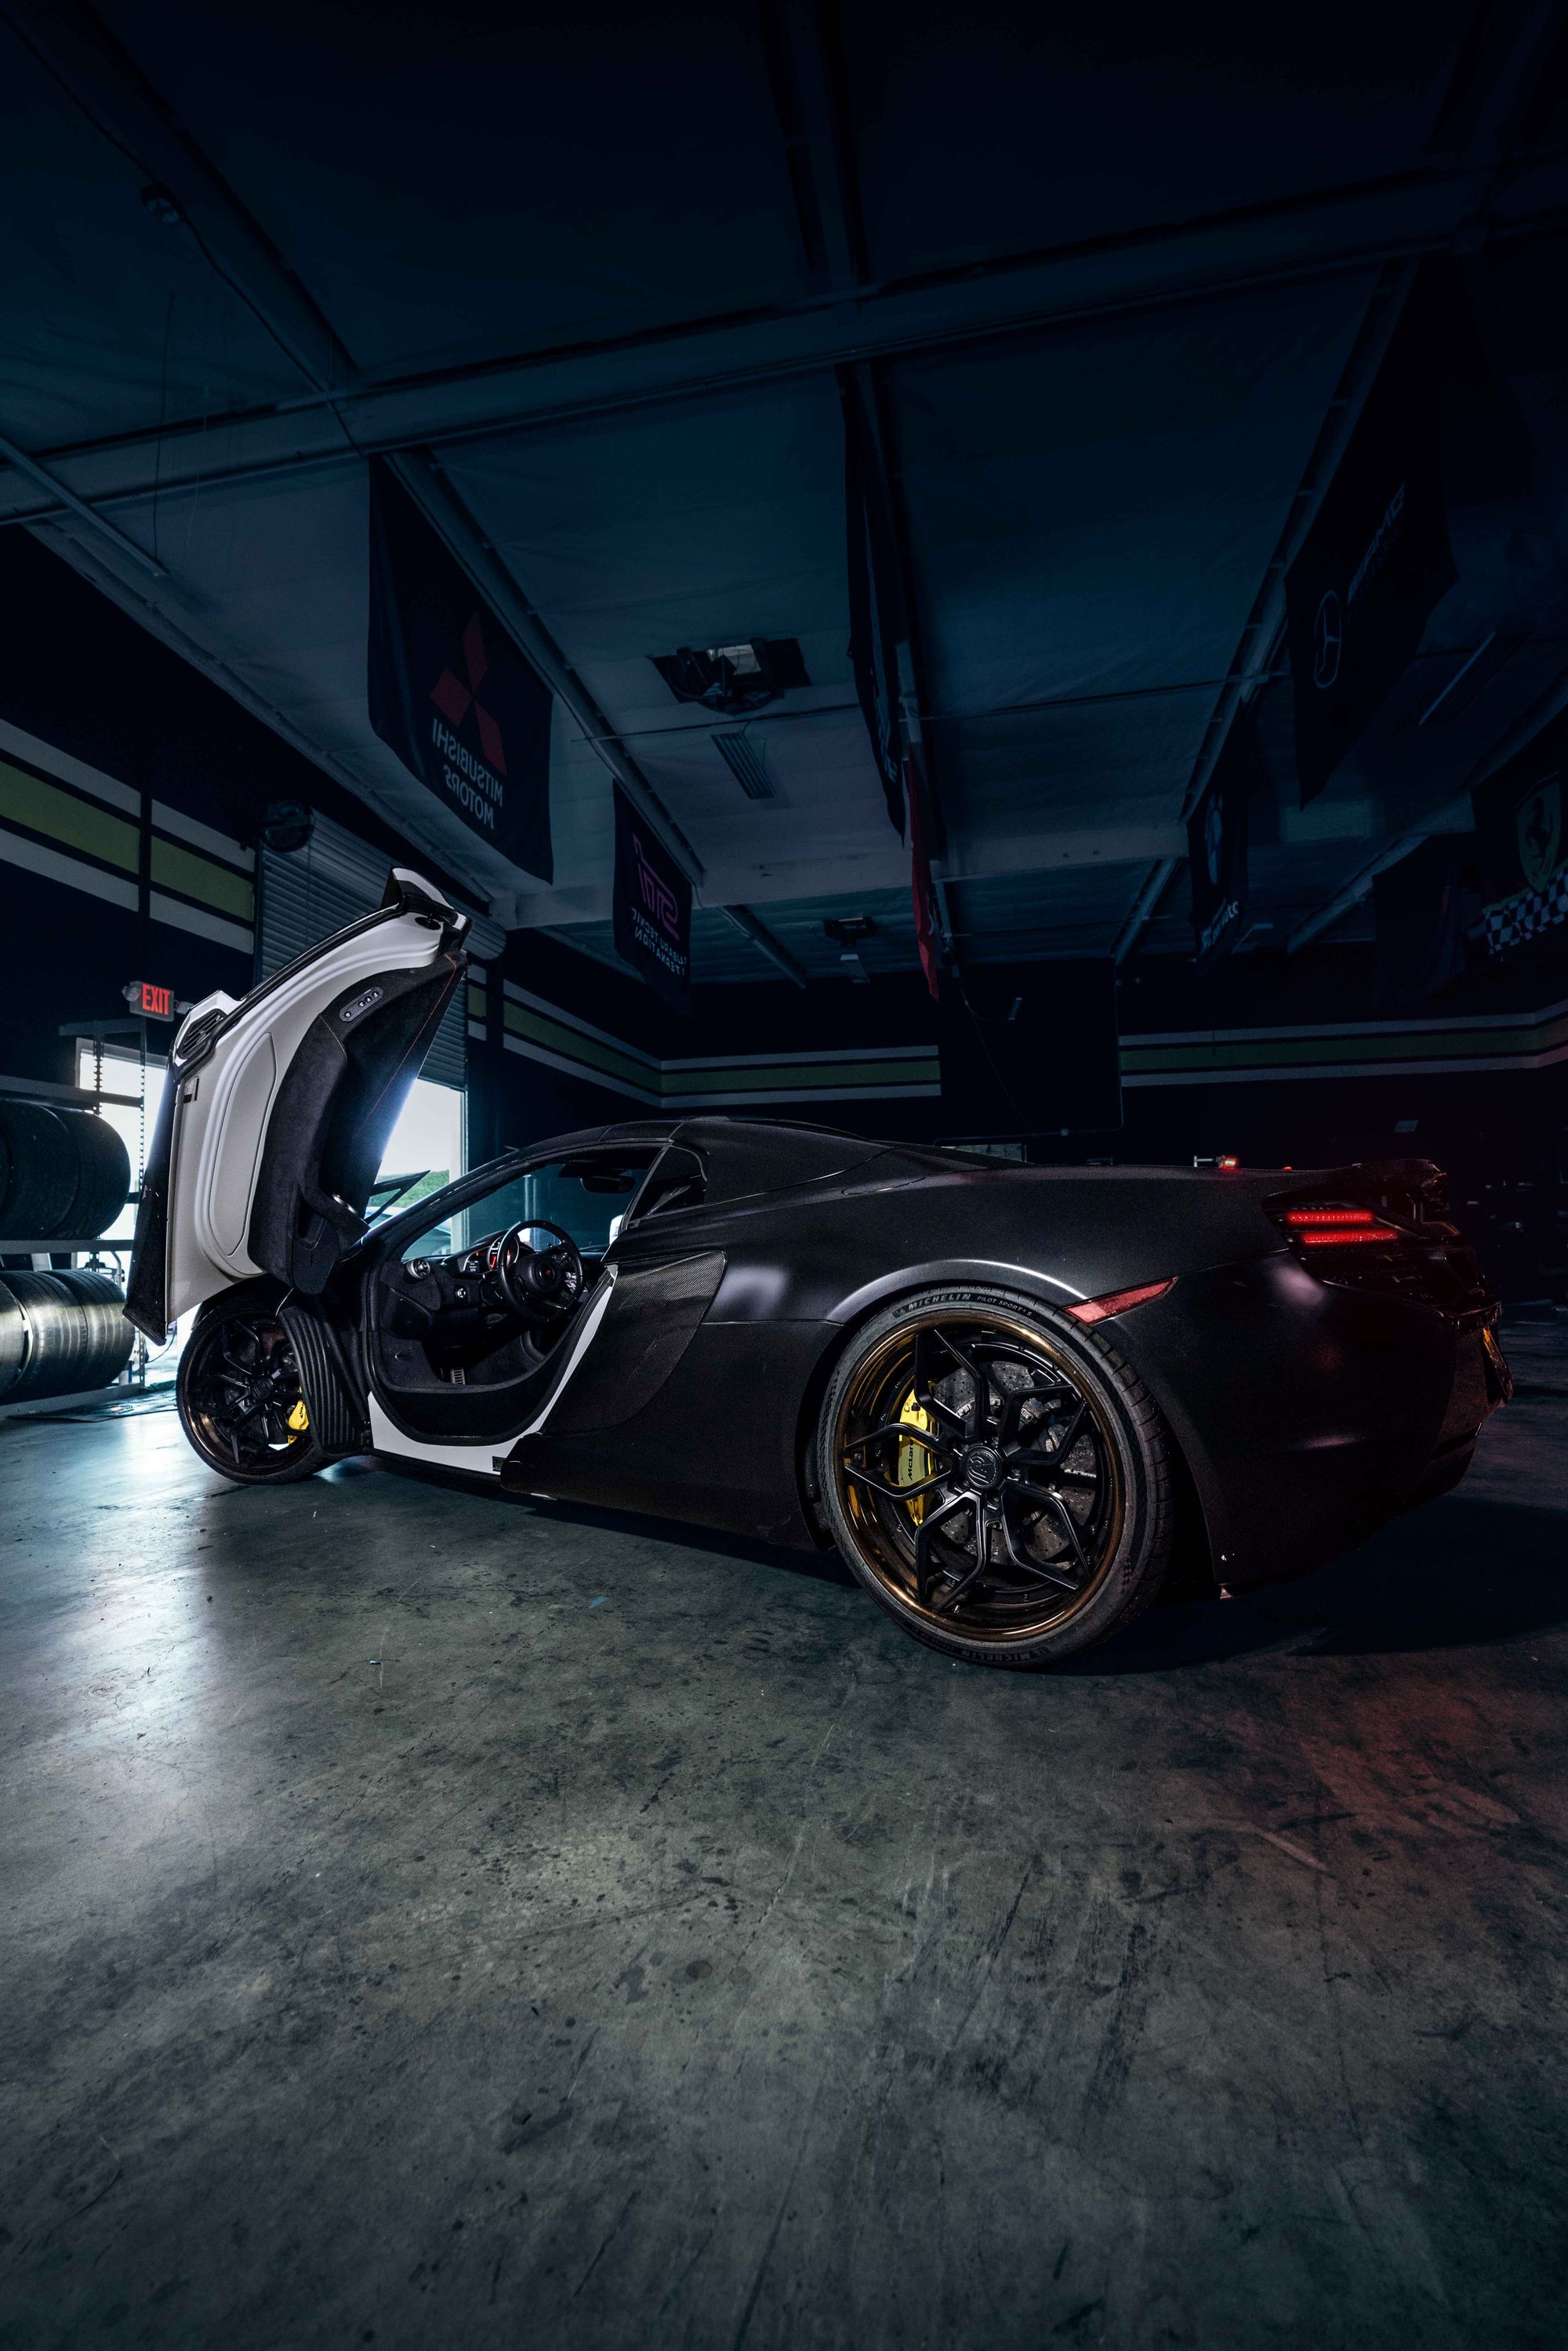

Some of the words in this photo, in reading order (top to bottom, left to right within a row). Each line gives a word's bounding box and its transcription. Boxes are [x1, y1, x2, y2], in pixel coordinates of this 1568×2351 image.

[143, 983, 171, 1016] EXIT
[908, 1293, 971, 1310] MICHELIN
[998, 1300, 1022, 1311] SPORT
[961, 1649, 1031, 1662] MICHELIN
